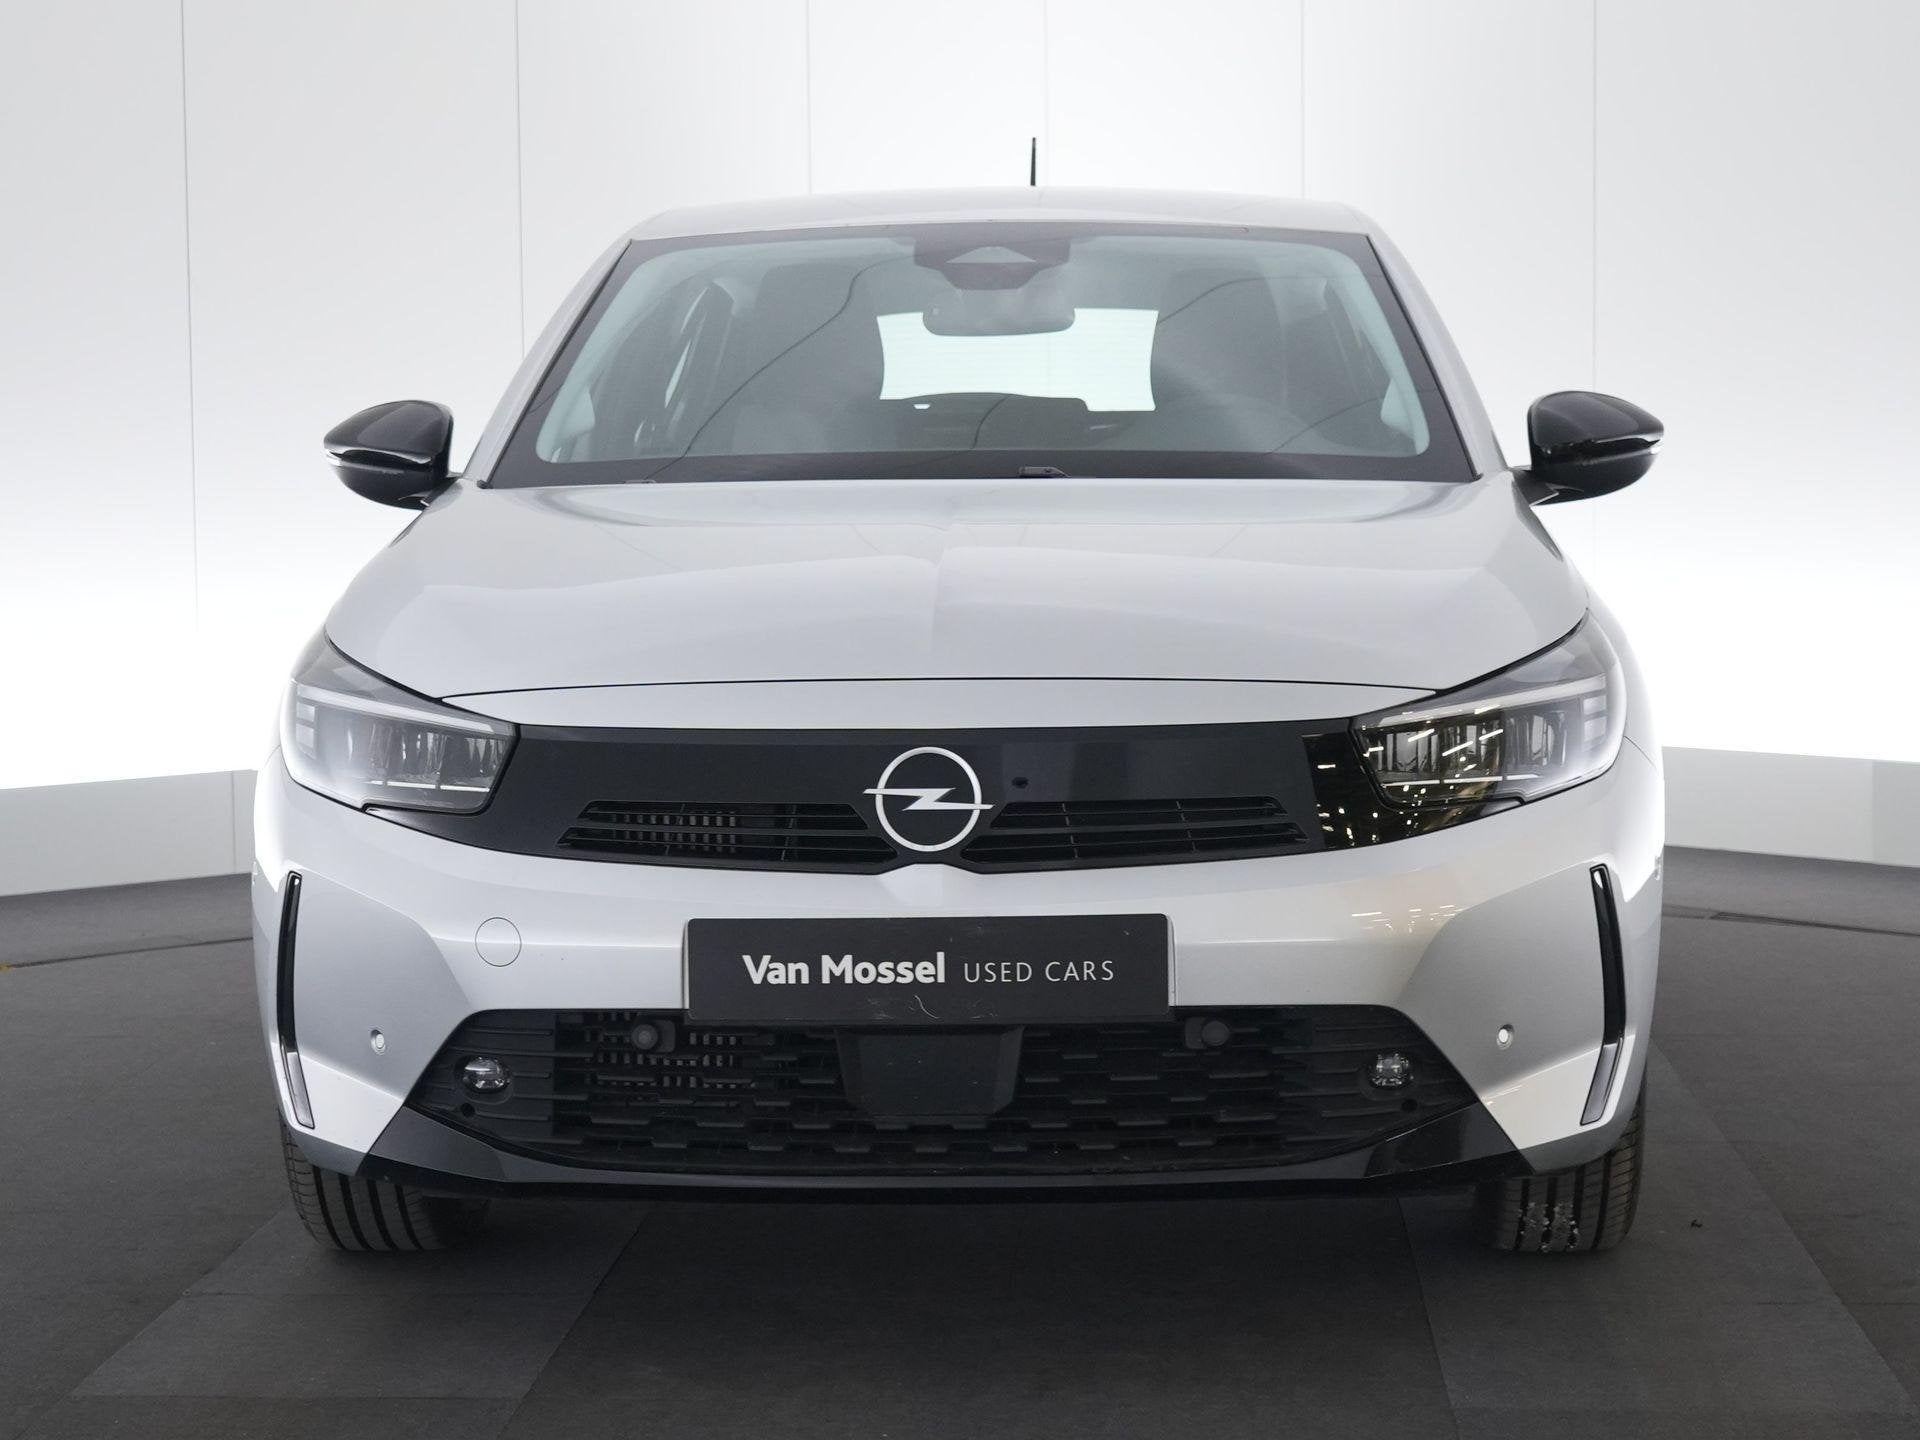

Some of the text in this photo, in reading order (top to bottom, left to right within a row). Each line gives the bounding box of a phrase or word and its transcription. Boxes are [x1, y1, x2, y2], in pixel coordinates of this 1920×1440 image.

[742, 951, 1114, 985] Van Mossel USED CARS
